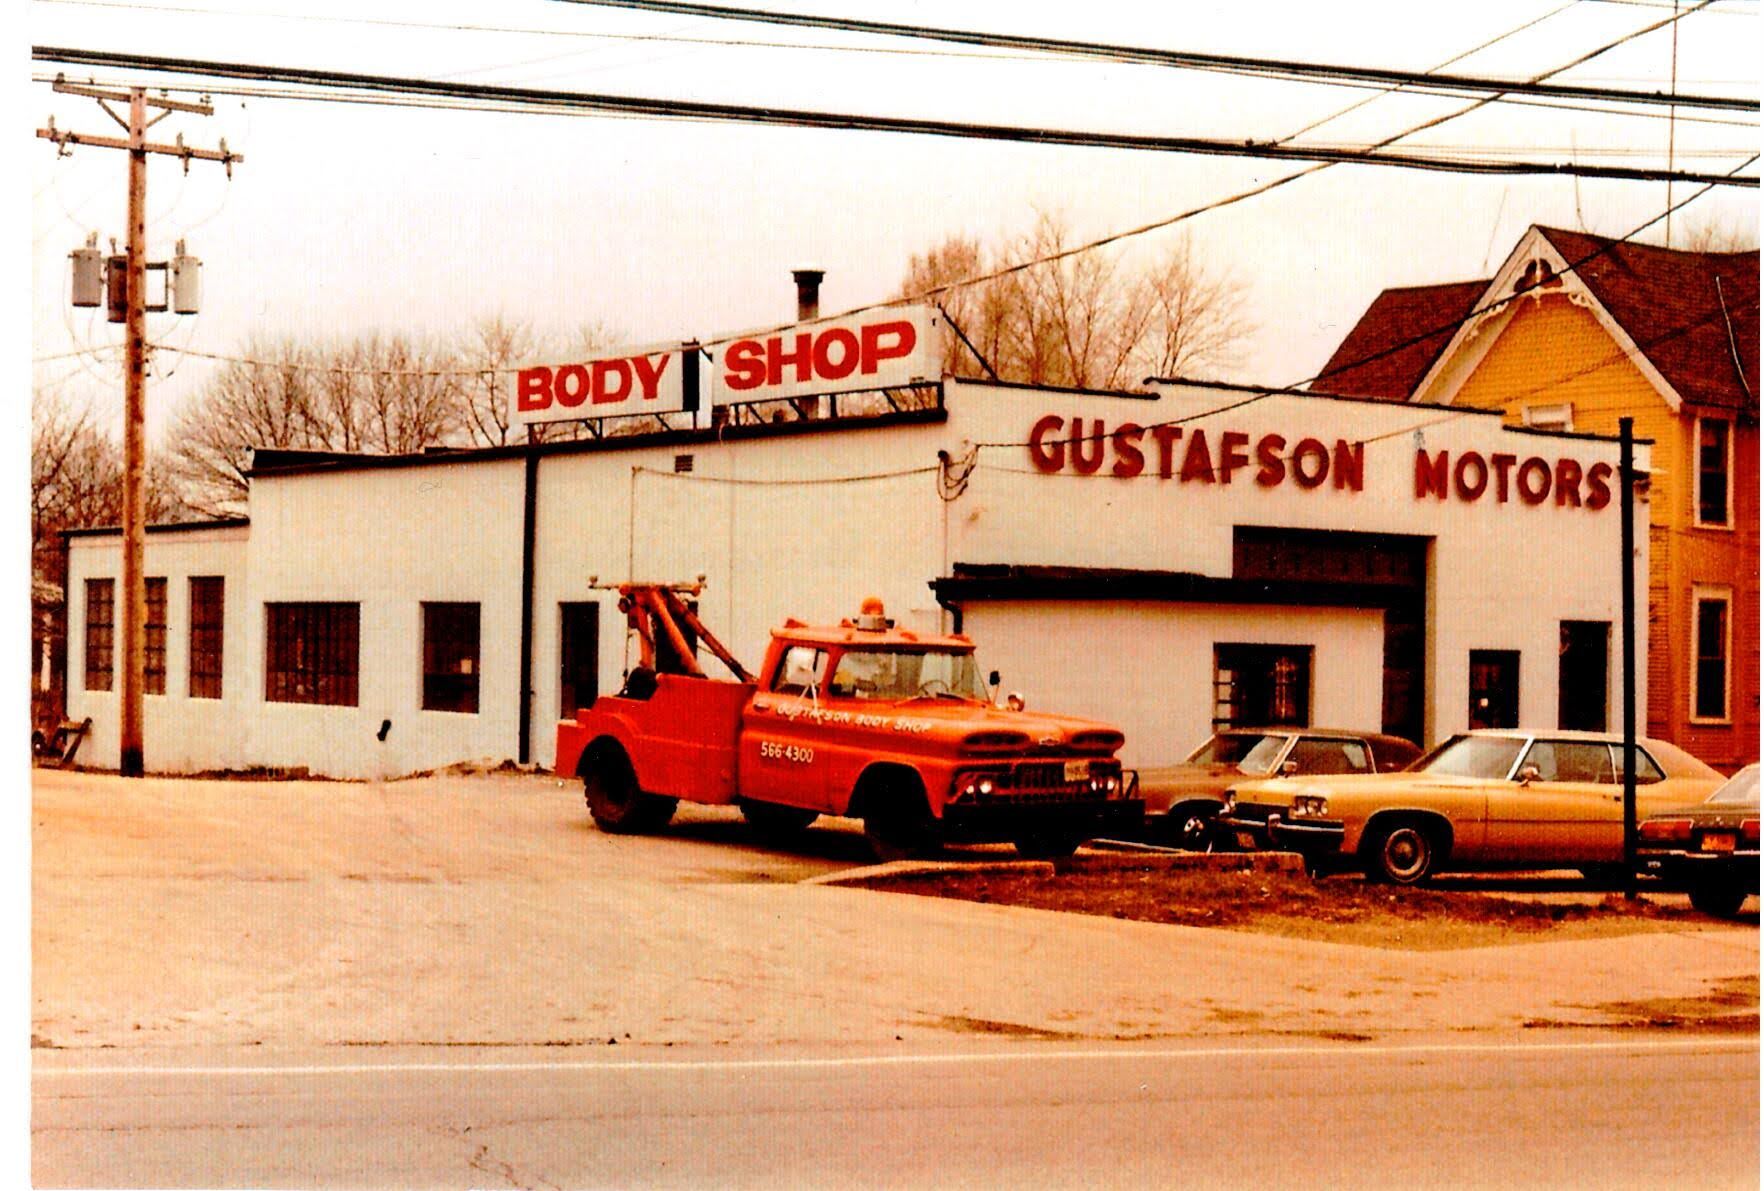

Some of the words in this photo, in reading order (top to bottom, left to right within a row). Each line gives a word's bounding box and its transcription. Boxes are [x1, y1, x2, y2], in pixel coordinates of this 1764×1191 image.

[517, 353, 670, 412] BODY
[724, 320, 916, 390] SHOP
[1029, 415, 1364, 492] GUSTAFSON
[1415, 448, 1615, 510] MOTORS
[855, 713, 889, 727] BODY
[894, 716, 933, 734] SHOP
